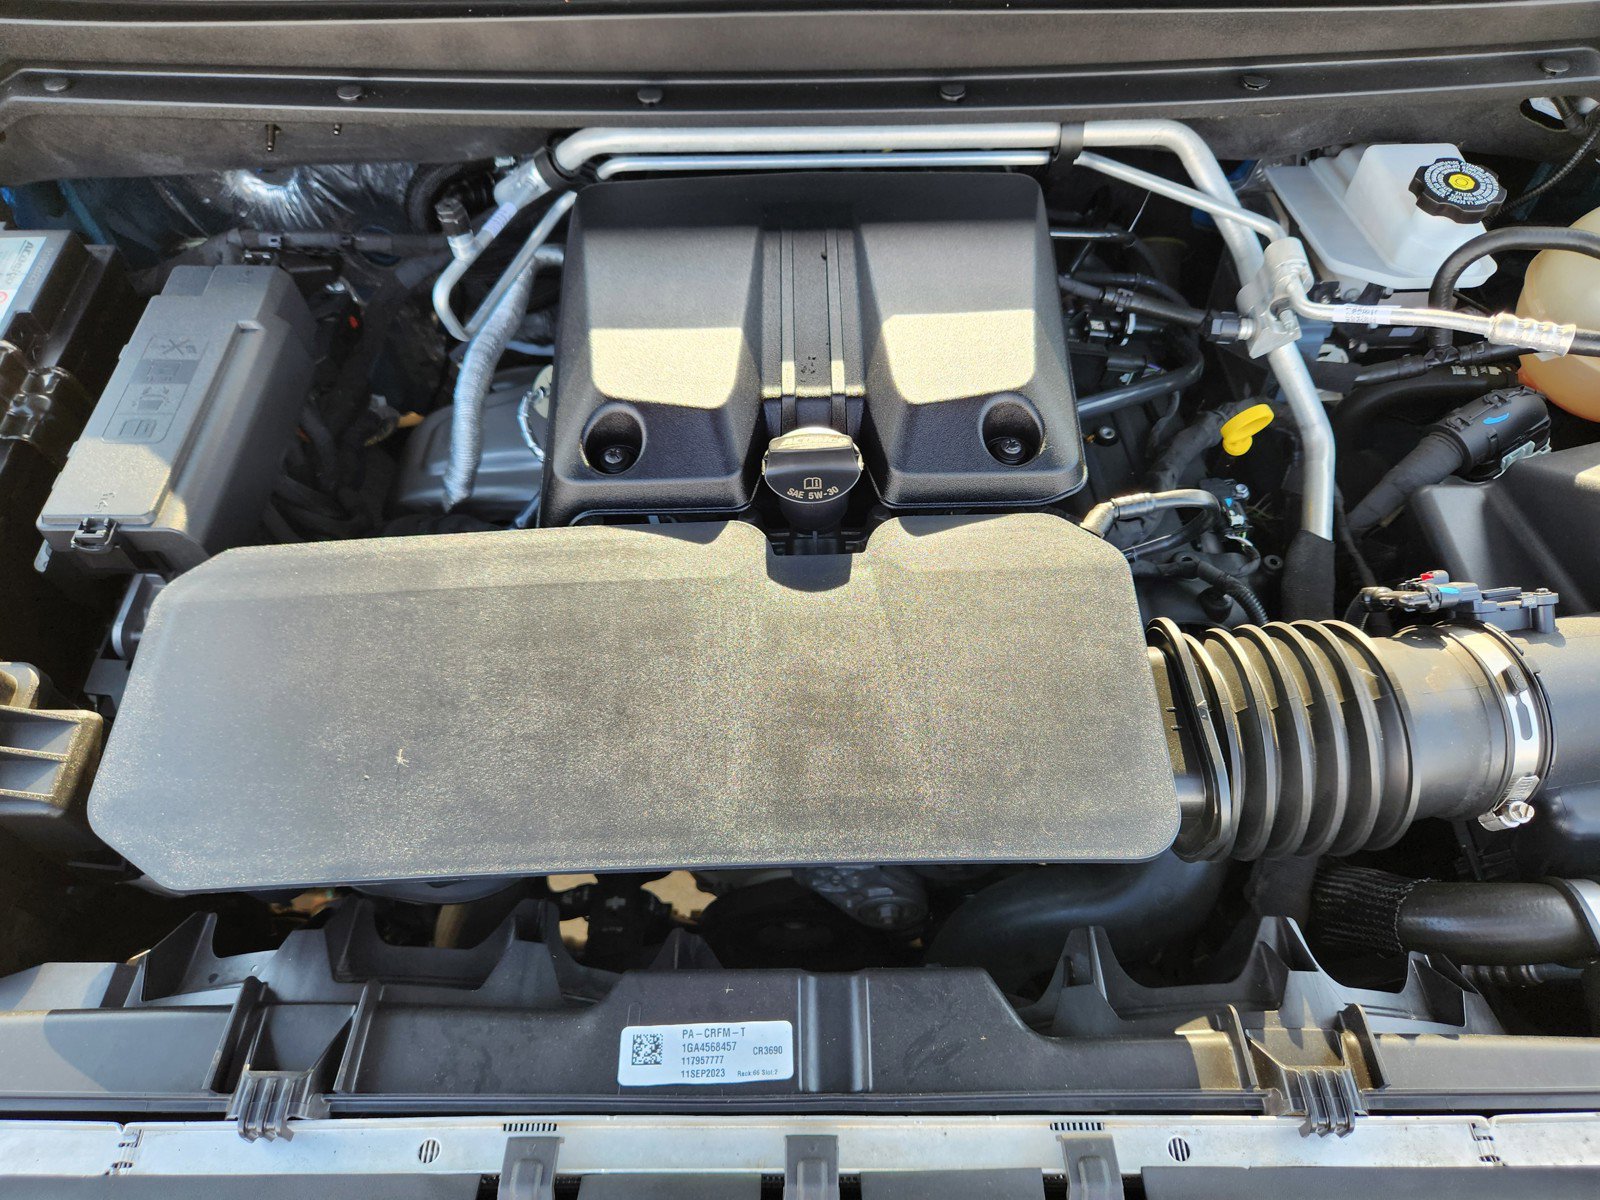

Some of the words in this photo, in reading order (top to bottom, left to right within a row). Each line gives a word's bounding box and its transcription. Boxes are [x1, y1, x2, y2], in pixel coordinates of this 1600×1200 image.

[787, 488, 804, 499] SAE
[808, 486, 839, 500] 5W-30
[682, 1041, 737, 1053] 1GA4568457
[753, 1046, 783, 1055] CR3690
[681, 1055, 724, 1066] 117957777
[680, 1068, 726, 1079] 11SEP2023
